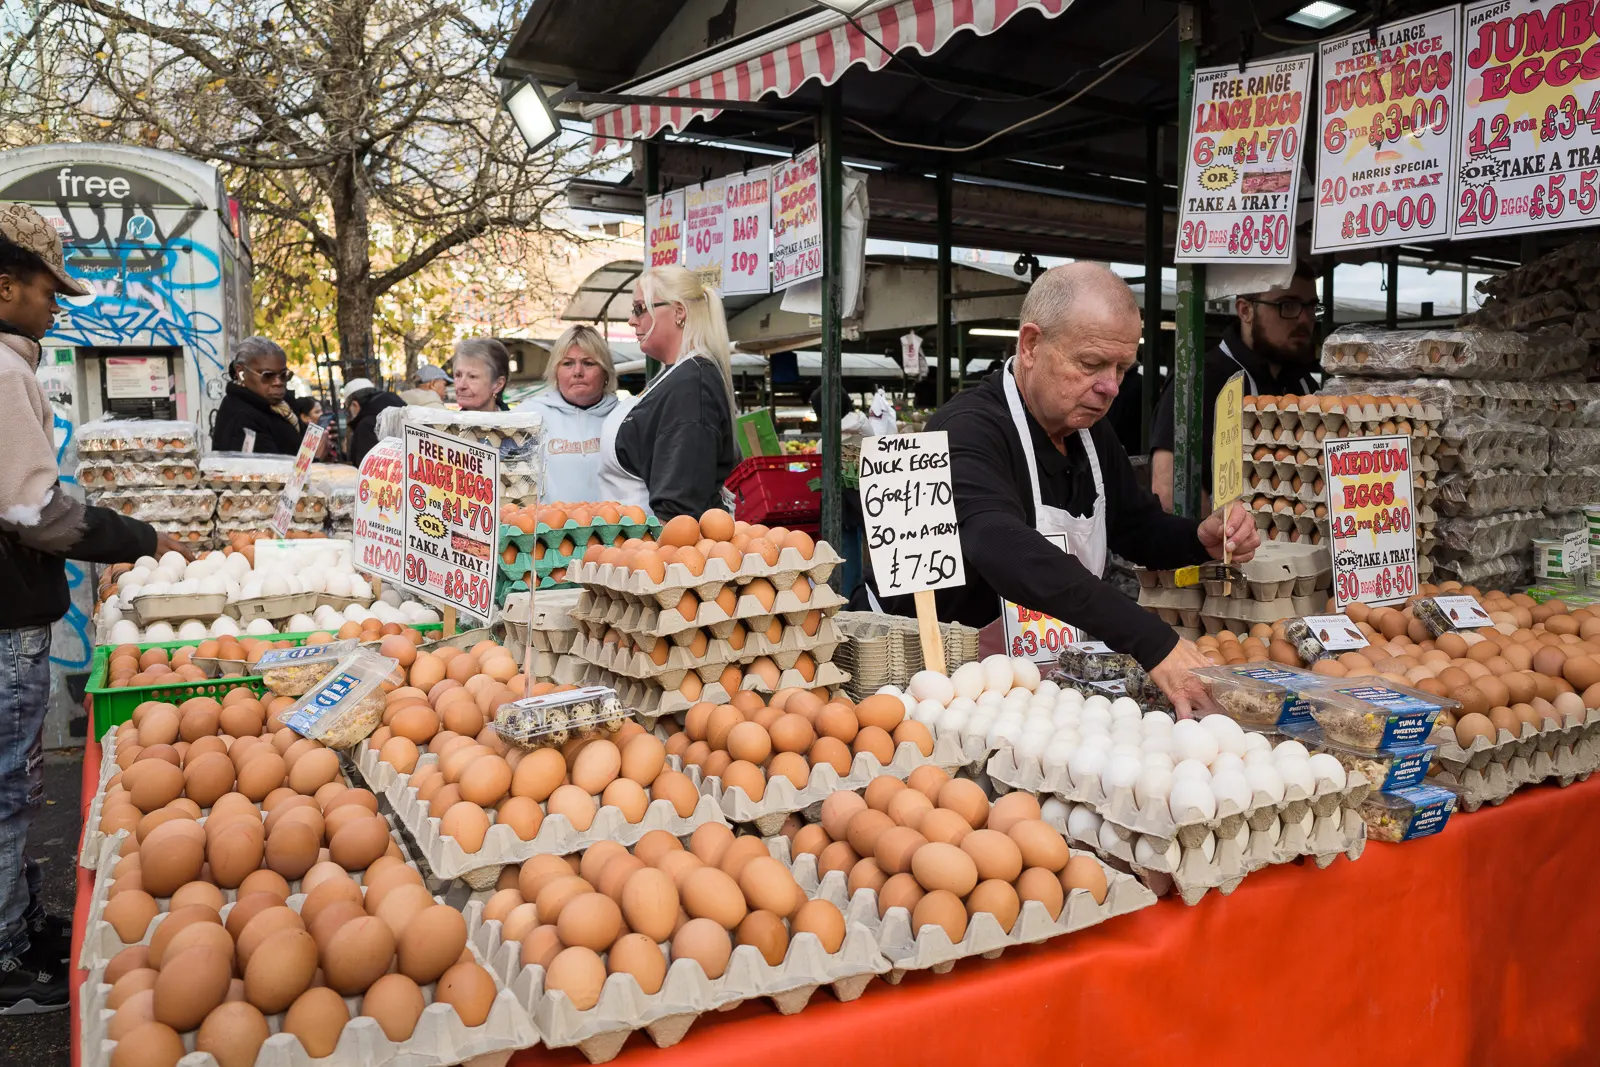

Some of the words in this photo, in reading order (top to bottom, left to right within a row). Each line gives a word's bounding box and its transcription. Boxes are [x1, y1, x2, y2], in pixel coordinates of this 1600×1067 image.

[1470, 1, 1511, 26] HARRIS
[1389, 24, 1426, 46] LARGE
[1468, 0, 1600, 69] JUMB
[1323, 40, 1349, 55] HARRIS
[1335, 53, 1377, 75] FREE
[1381, 36, 1442, 64] RANGE
[1199, 72, 1228, 83] HARRIS
[1276, 64, 1296, 73] CLASS
[1212, 79, 1243, 100] FREE
[1247, 73, 1291, 96] RANGE
[1325, 67, 1386, 115] DUCK
[1390, 51, 1452, 100] EGGS
[1195, 98, 1252, 133] LARGE
[1253, 92, 1302, 127] EGGS
[1324, 118, 1347, 154] 6
[1349, 126, 1368, 139] FOR
[1469, 113, 1512, 156] 12
[1513, 118, 1537, 134] FOR
[1193, 137, 1215, 167] 6
[1218, 145, 1233, 155] FOR
[774, 156, 818, 193] LARGE
[1207, 172, 1229, 183] OR
[1352, 166, 1391, 181] HARRIS
[1394, 159, 1439, 174] SPECIAL
[1466, 163, 1496, 179] OR
[1501, 153, 1545, 178] TAKE
[1549, 151, 1562, 170] A
[57, 168, 130, 199] free
[726, 179, 768, 210] CARRIER
[1320, 176, 1347, 207] 20
[1350, 183, 1374, 198] ON
[1376, 182, 1391, 194] A
[1392, 172, 1443, 191] TRAY
[660, 199, 672, 217] 12
[780, 183, 816, 215] EGGS
[1188, 197, 1223, 212] TAKE
[1226, 199, 1237, 210] A
[1459, 185, 1499, 227] 20
[1500, 196, 1529, 216] EGGS
[651, 224, 680, 248] QUAIL
[733, 215, 758, 242] BAGS
[774, 219, 786, 238] 12
[1180, 220, 1207, 253] 30
[1208, 229, 1227, 244] EGGS
[696, 229, 711, 254] 60
[785, 242, 798, 255] TAKE
[799, 241, 803, 250] A
[651, 248, 678, 267] EGGS
[731, 253, 758, 275] 10p
[775, 261, 785, 282] 30
[407, 429, 429, 439] HARRIS
[878, 437, 920, 453] SMALL
[418, 439, 444, 461] FREE
[447, 448, 483, 474] RANGE
[469, 448, 485, 458] CLASS
[1328, 443, 1350, 454] HARRIS
[362, 455, 390, 480] DUCK
[860, 457, 903, 478] DUCK
[910, 453, 948, 471] EGGS
[1330, 448, 1408, 476] MEDIUM
[360, 479, 369, 504] 6
[408, 453, 454, 492] LARGE
[455, 469, 494, 505] EGGS
[408, 484, 427, 512] 6
[429, 499, 442, 510] FOR
[865, 484, 883, 517] 6
[883, 488, 903, 502] FOR
[1343, 482, 1394, 509] EGGS
[356, 518, 367, 537] 20
[385, 535, 402, 547] TRA
[369, 521, 385, 532] HARRIS
[423, 519, 440, 532] OR
[870, 525, 895, 549] 30
[921, 525, 928, 539] A
[930, 523, 958, 536] TRAY
[1333, 516, 1357, 538] 12
[1358, 520, 1372, 530] FOR
[409, 535, 439, 557] TAKE
[441, 546, 449, 560] A
[1339, 556, 1355, 566] OR
[1358, 551, 1380, 567] TAKE
[1383, 552, 1388, 564] A
[405, 553, 427, 585] 30
[428, 569, 444, 586] EGGS
[1338, 571, 1359, 602] 30
[1361, 581, 1375, 593] EGGS
[1394, 767, 1421, 776] SWEETCORN
[1415, 816, 1442, 826] SWEETCORN
[1421, 810, 1435, 818] TUNA
